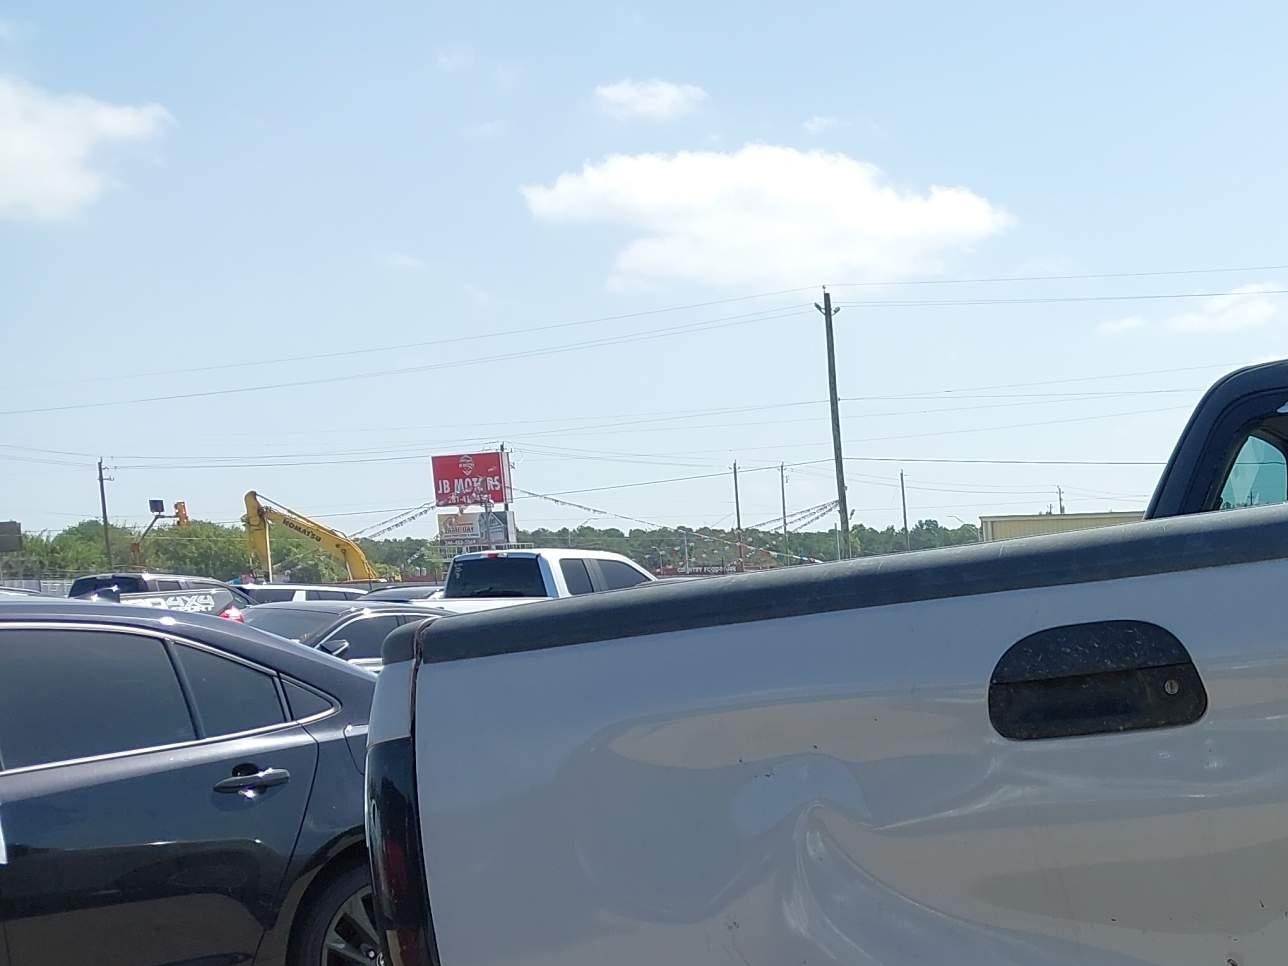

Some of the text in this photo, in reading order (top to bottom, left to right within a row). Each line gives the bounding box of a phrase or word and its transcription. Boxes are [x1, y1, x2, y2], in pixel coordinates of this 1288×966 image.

[438, 476, 501, 495] JB MOTRS
[282, 519, 322, 542] KOMATSU
